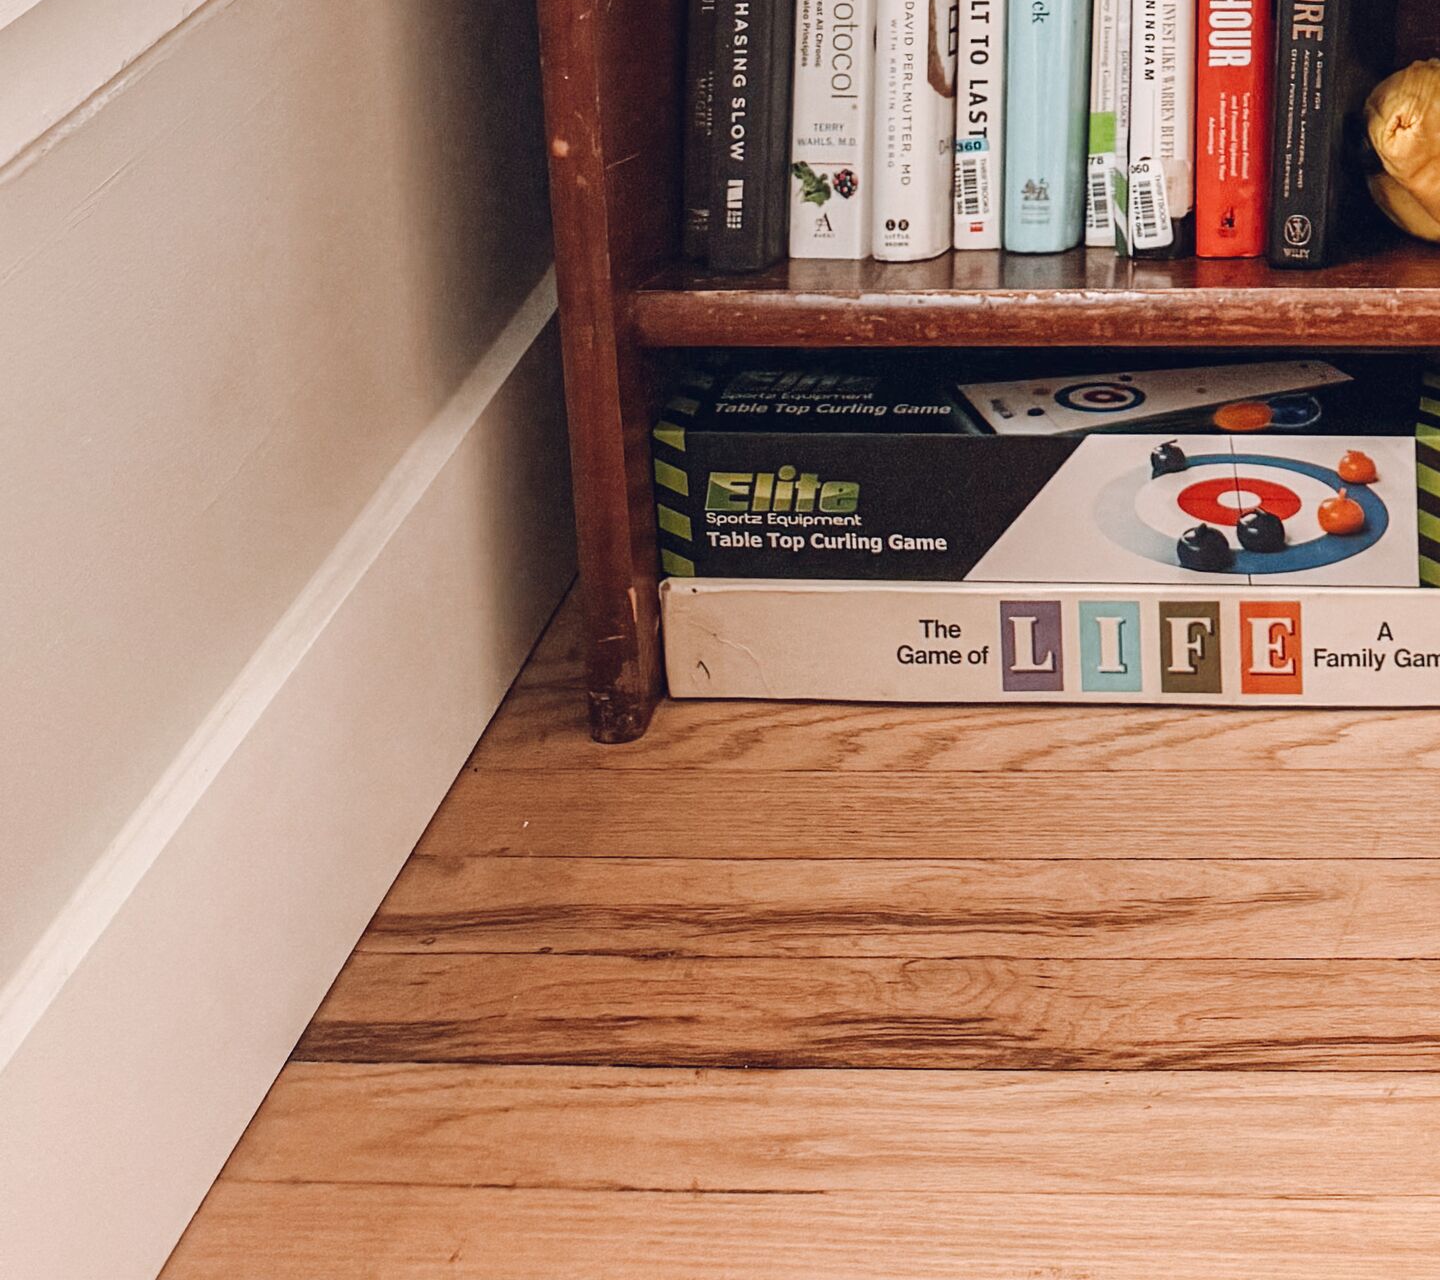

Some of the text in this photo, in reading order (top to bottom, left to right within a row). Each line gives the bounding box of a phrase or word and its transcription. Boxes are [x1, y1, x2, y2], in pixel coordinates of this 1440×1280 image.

[970, 35, 989, 65] TO
[968, 79, 988, 137] LAST
[729, 96, 746, 161] SLOW
[704, 465, 860, 513] Elite
[706, 512, 862, 527] Sportz Equipment
[707, 531, 948, 553] Table Top Curling Game
[918, 619, 962, 639] The
[896, 645, 989, 665] Game of
[1008, 616, 1295, 674] LIFE
[1313, 649, 1386, 672] Family
